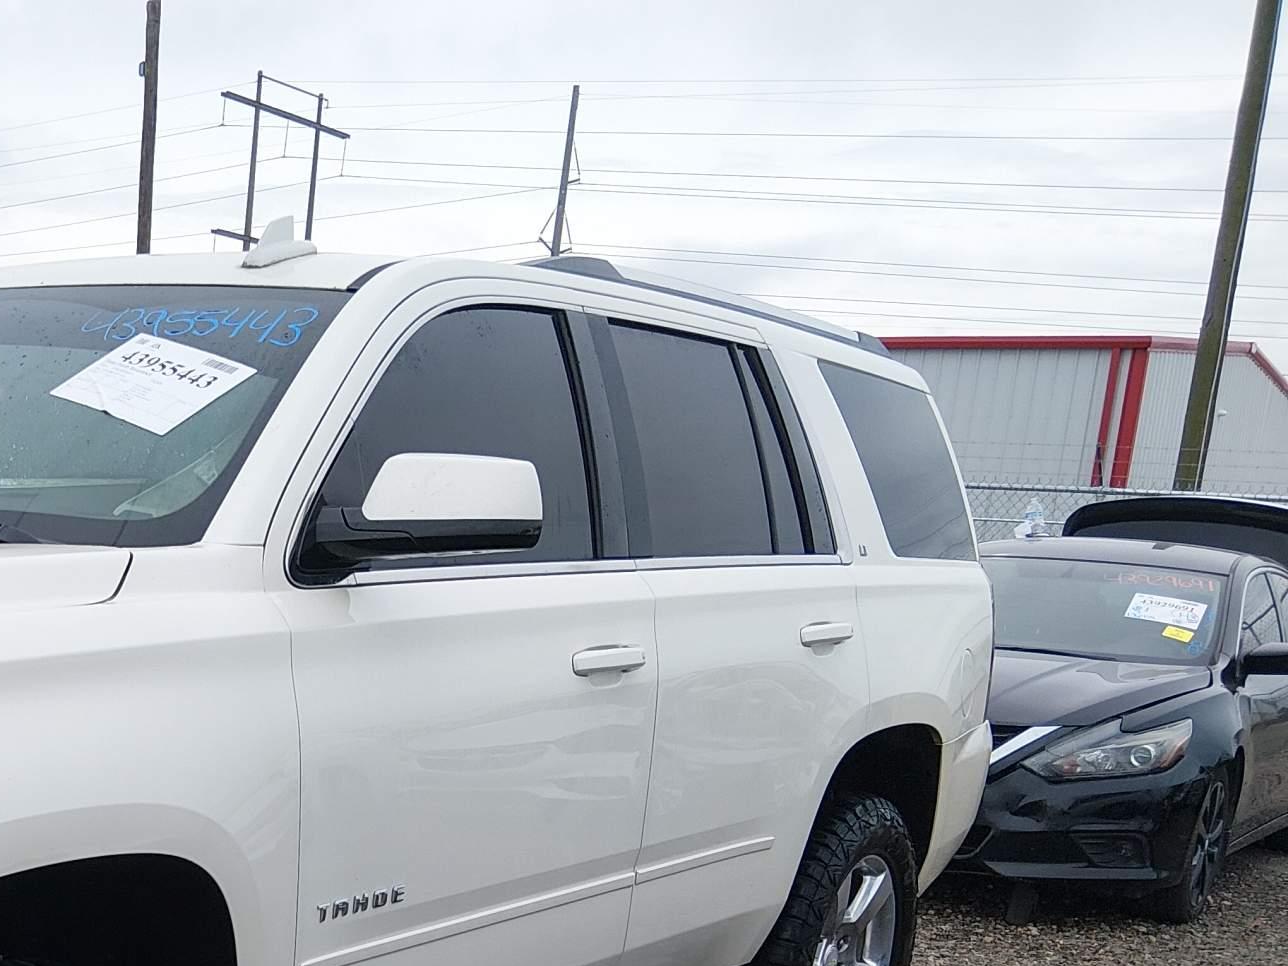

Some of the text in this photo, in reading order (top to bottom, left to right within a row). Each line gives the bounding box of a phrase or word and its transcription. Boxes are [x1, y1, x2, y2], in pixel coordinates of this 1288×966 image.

[80, 306, 319, 346] 43955443
[120, 350, 219, 389] 43955443
[316, 884, 407, 923] TAHOE
